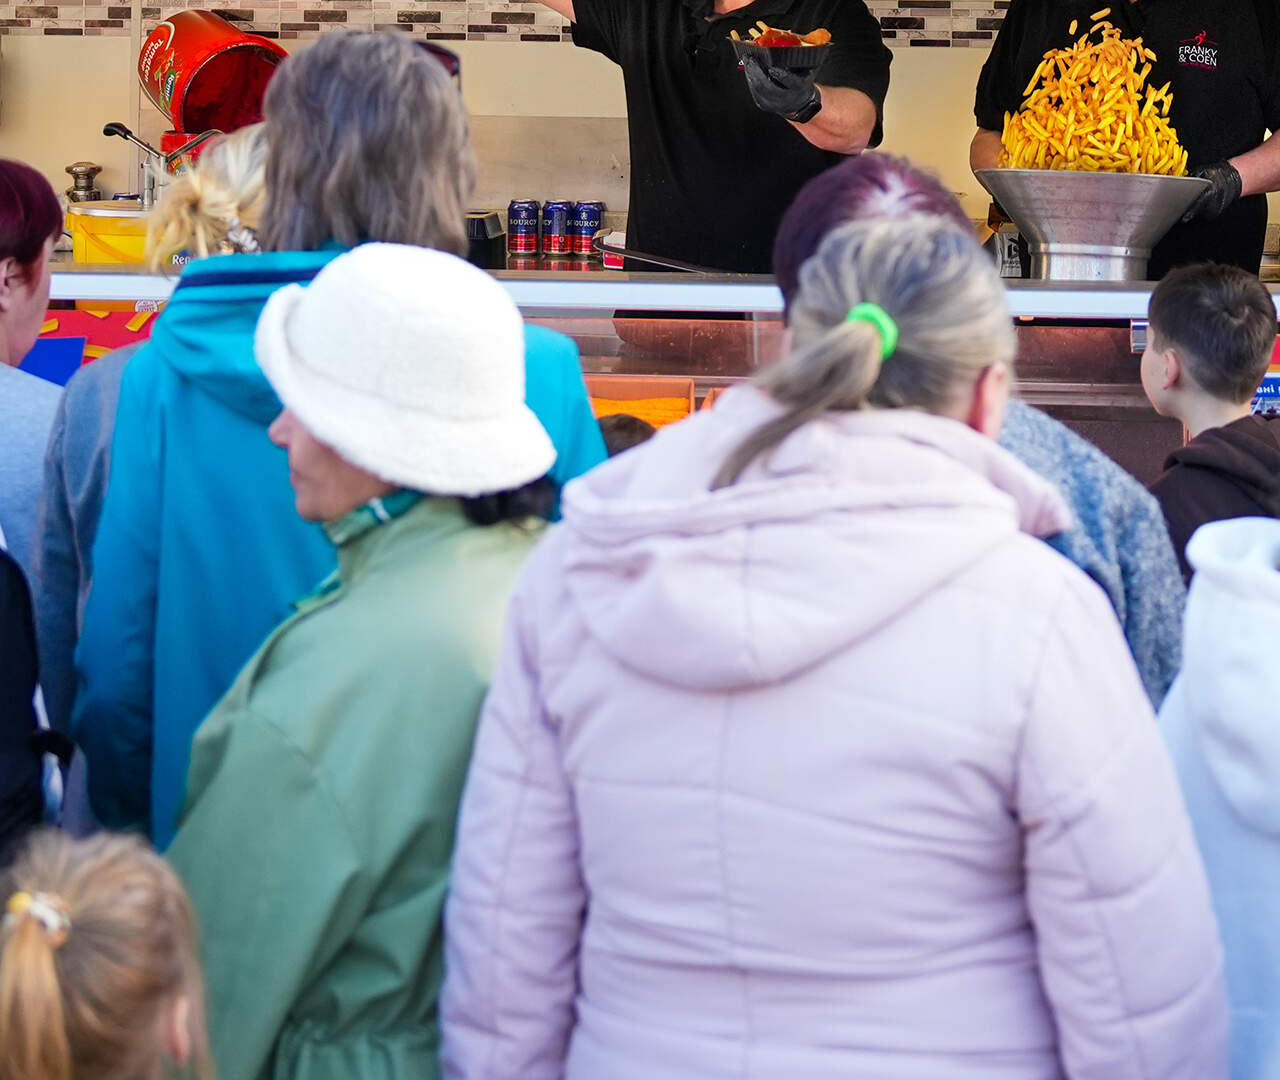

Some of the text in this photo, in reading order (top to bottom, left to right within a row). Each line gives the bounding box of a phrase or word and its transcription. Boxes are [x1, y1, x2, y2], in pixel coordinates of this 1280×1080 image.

[1178, 45, 1218, 57] FRANKY
[1178, 53, 1187, 62] &
[1189, 53, 1217, 67] COEN
